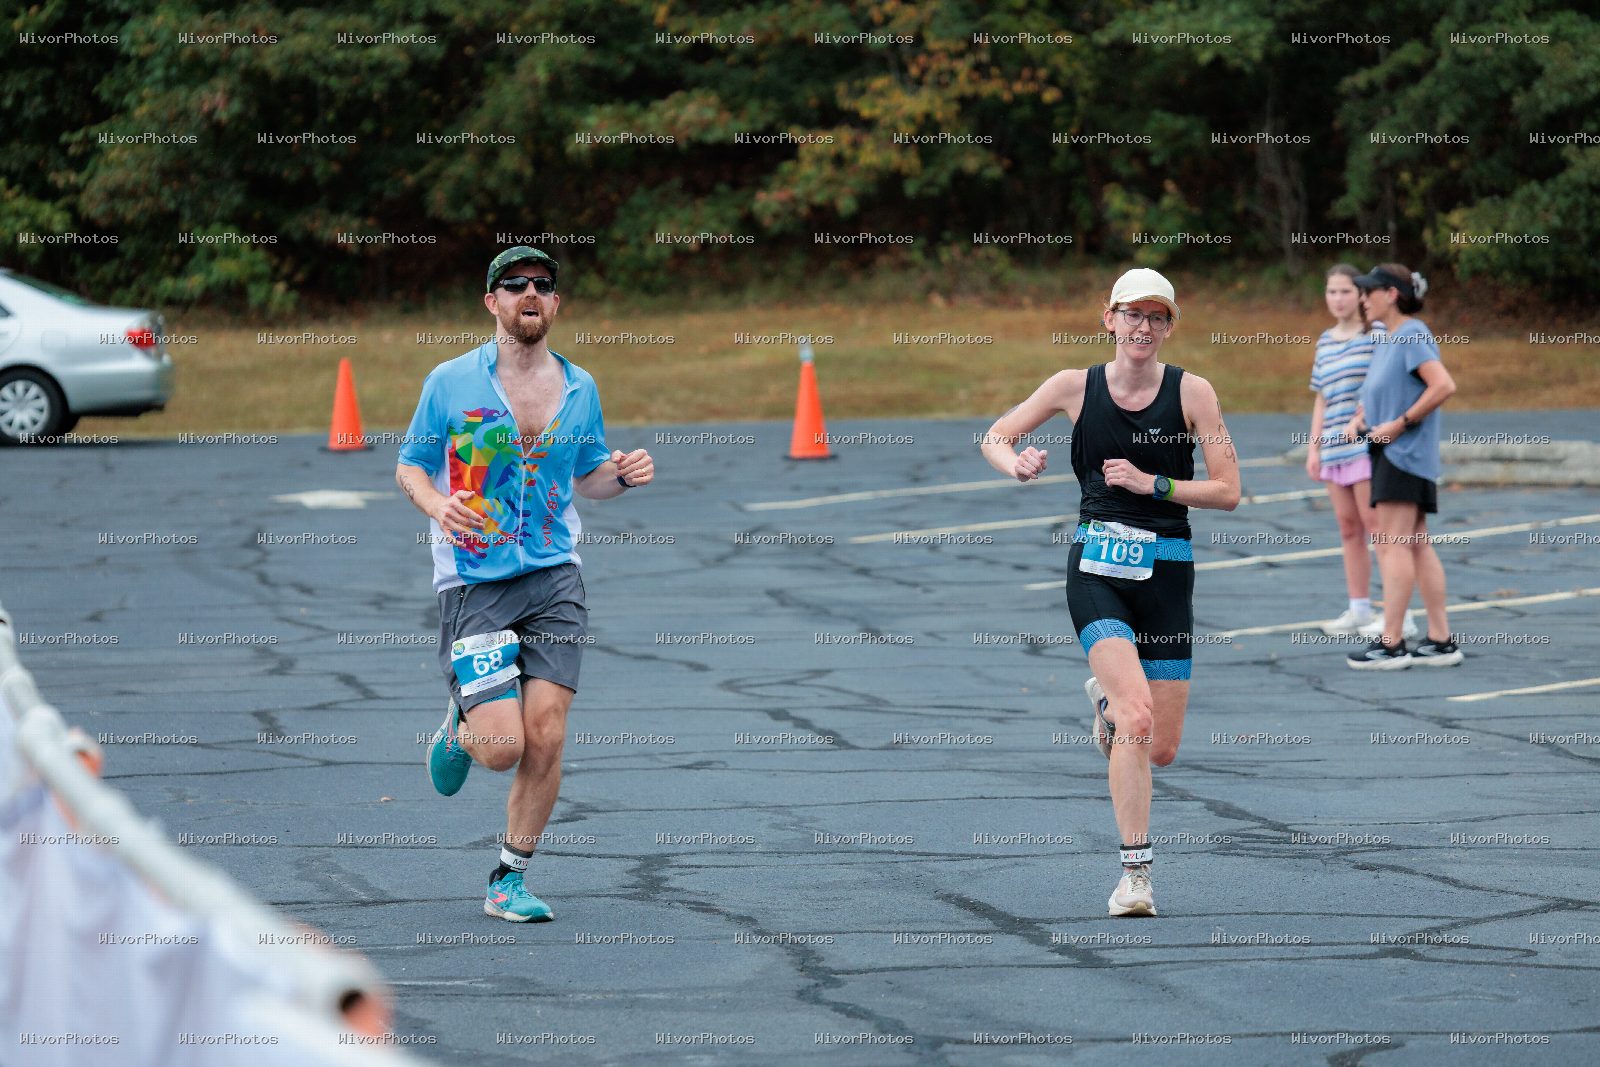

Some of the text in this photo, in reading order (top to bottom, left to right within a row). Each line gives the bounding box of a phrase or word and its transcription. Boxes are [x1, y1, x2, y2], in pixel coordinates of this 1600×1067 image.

[541, 479, 559, 547] ALBANIA
[1099, 539, 1144, 566] 109
[472, 649, 504, 676] 68
